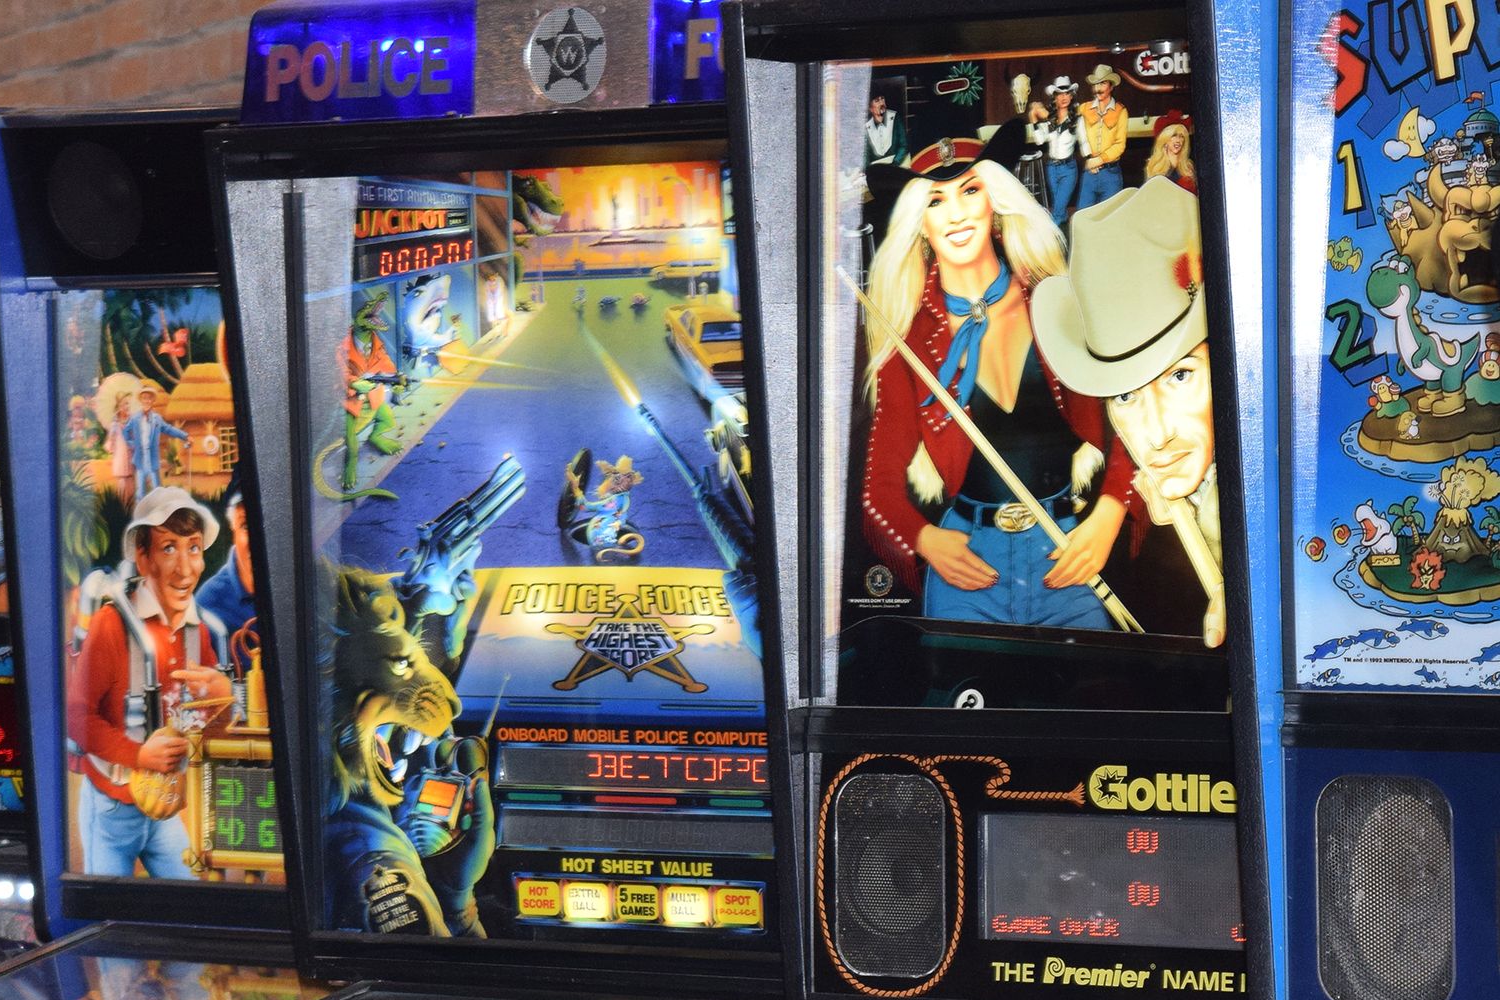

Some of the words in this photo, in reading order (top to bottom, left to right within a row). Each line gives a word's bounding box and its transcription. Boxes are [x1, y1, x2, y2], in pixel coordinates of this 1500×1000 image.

[266, 37, 453, 102] POLICE
[379, 187, 404, 202] FIRST
[354, 208, 448, 238] JACKPOT
[501, 583, 618, 616] POLICE
[638, 584, 732, 617] FORCE
[596, 622, 631, 633] TAKE
[633, 622, 665, 633] THE
[586, 633, 674, 649] HIGHEST
[597, 650, 662, 668] SCORE
[498, 727, 568, 742] ONBOARD
[574, 728, 629, 743] MOBILE
[635, 729, 689, 744] POLICE
[561, 857, 595, 873] HOT
[602, 858, 654, 875] SHEET
[661, 860, 714, 877] VALUE
[528, 886, 549, 896] HOT
[619, 887, 628, 901] 5
[631, 893, 656, 904] FREE
[523, 898, 556, 910] SCORE
[572, 900, 597, 911] BALL
[724, 894, 751, 906] SPOT
[620, 904, 656, 917] GAMES
[671, 905, 696, 917] BALL
[992, 914, 1052, 936] GAME
[1059, 917, 1120, 938] OVER
[991, 961, 1036, 984] THE
[1042, 956, 1150, 988] Premier
[1162, 969, 1235, 993] NAME
